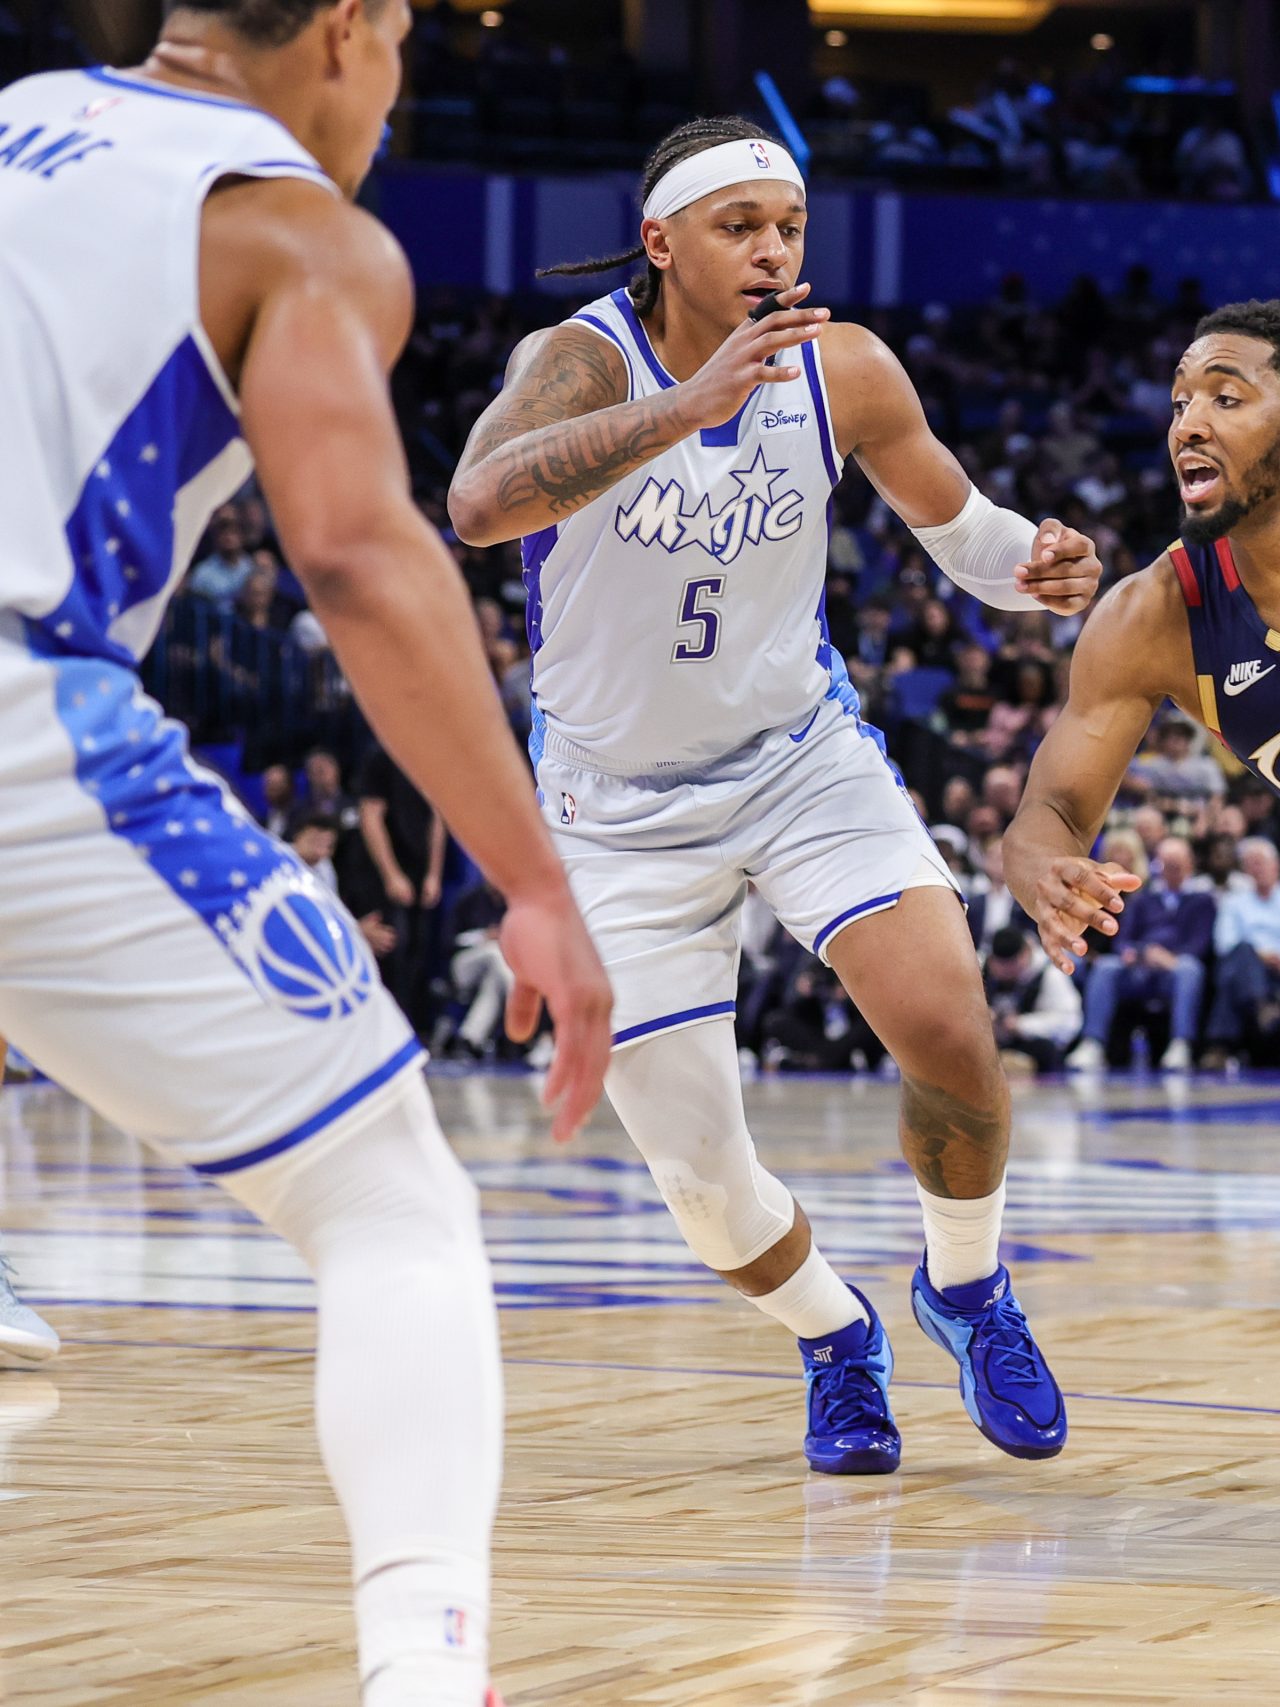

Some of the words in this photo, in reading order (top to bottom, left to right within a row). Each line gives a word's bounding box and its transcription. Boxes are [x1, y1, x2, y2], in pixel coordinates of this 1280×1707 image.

[0, 123, 114, 179] ANE
[670, 573, 728, 664] 5
[1229, 659, 1262, 684] NIKE
